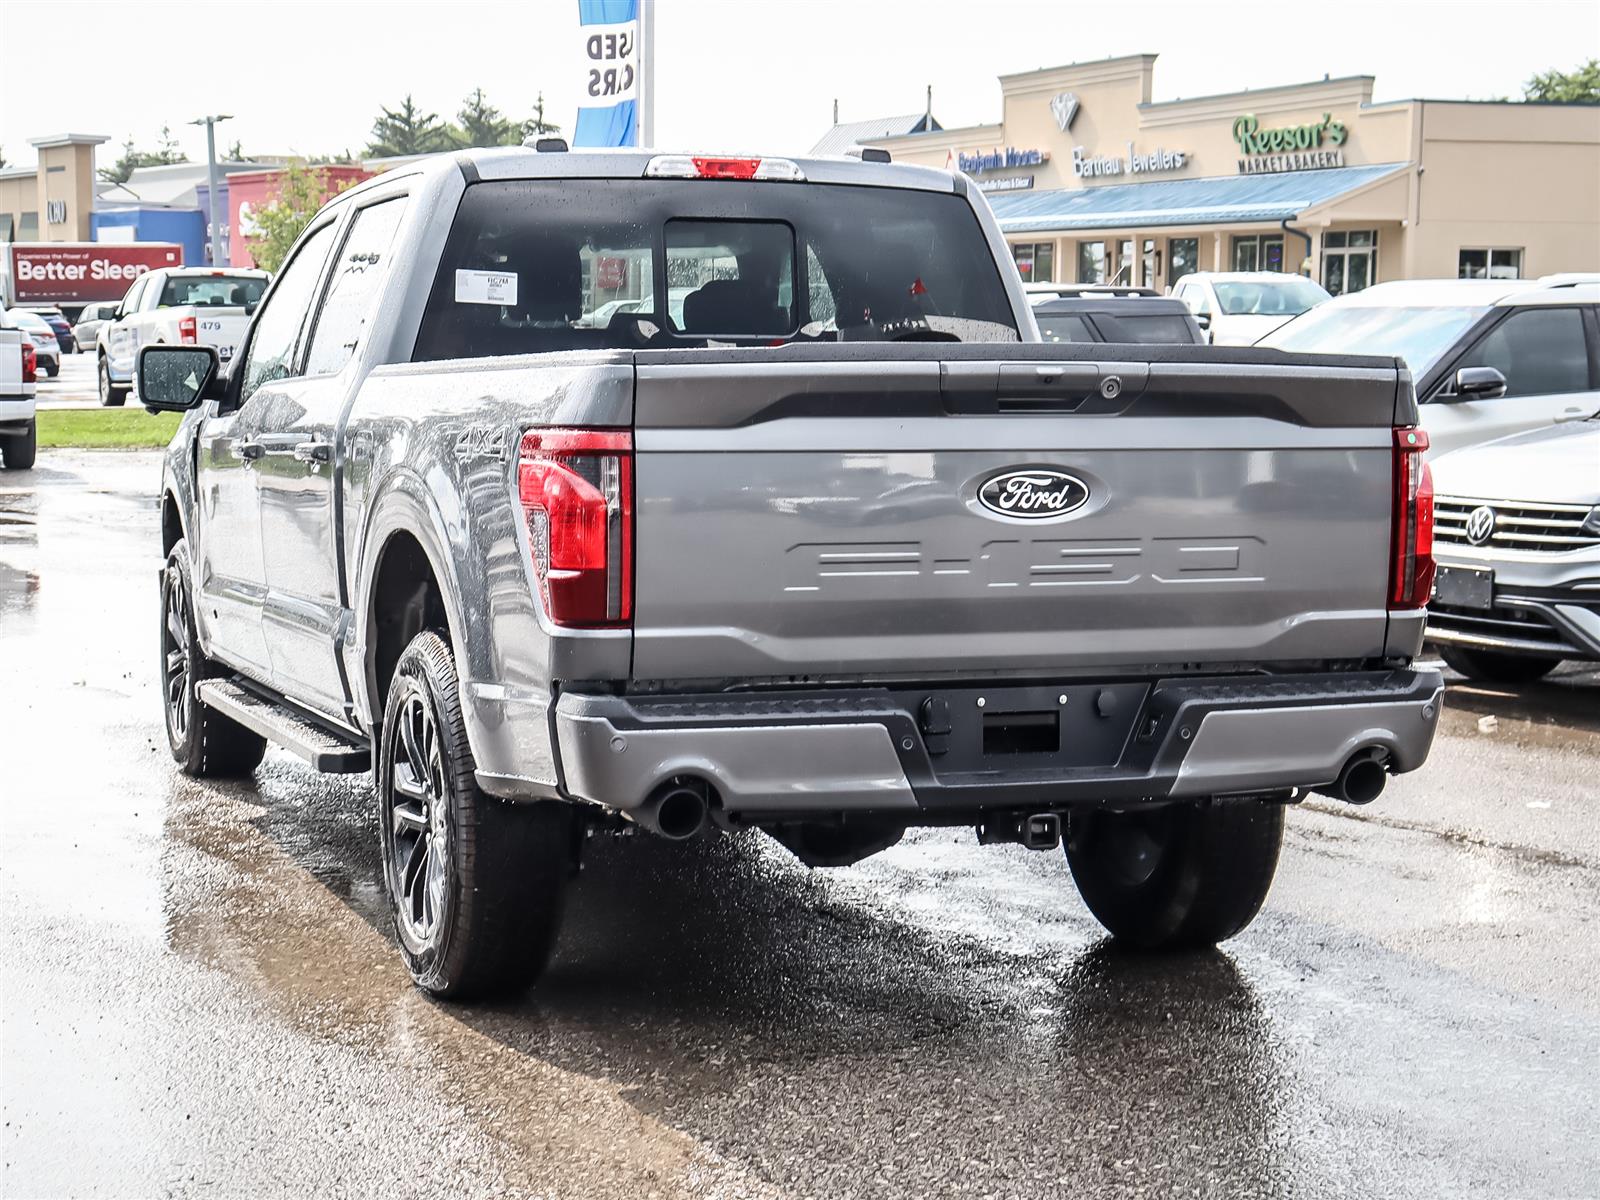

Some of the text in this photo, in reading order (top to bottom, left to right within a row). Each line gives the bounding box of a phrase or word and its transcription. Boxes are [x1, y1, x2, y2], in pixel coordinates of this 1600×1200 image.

[1233, 112, 1348, 154] Reesor's
[959, 146, 1042, 176] Benjamin Moore
[1124, 141, 1187, 174] Jewellers
[17, 260, 87, 281] Better
[200, 321, 221, 330] 479
[999, 477, 1069, 509] Ford
[784, 536, 1268, 592] F-150
